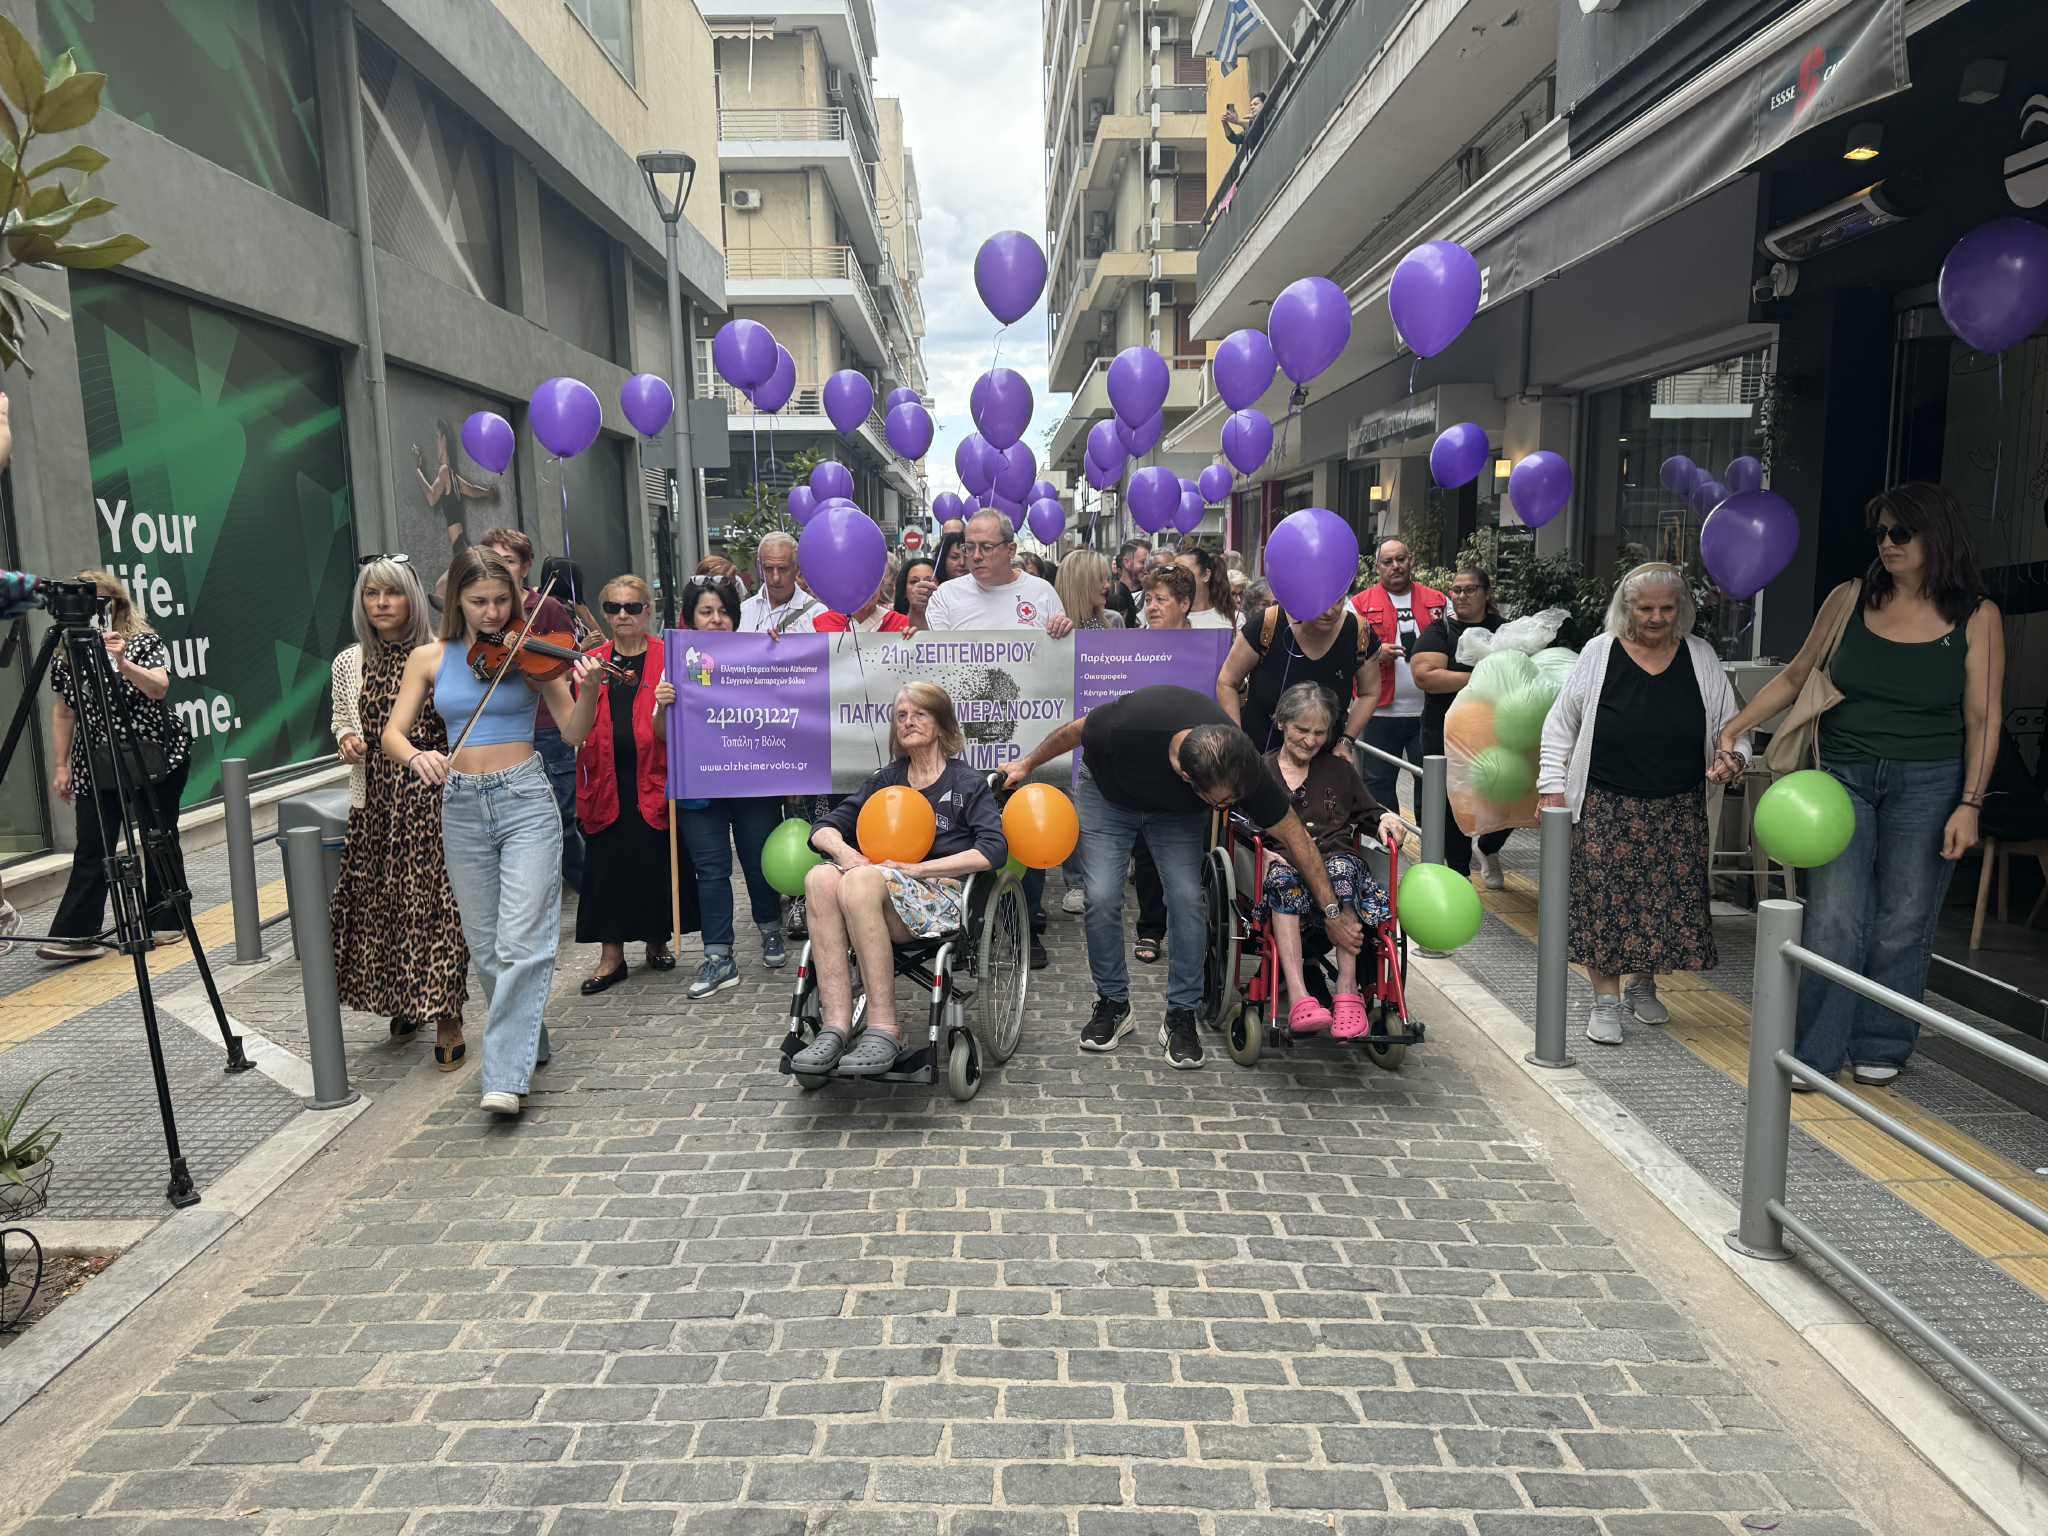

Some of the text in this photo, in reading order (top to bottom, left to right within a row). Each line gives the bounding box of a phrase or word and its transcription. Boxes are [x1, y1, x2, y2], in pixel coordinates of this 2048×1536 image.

[1770, 84, 1796, 111] ESSSE
[96, 499, 197, 553] Your
[163, 635, 210, 679] ur
[881, 642, 1035, 668] 21η ΣΕΠΤΕΜΒΡΙΟΥ
[1080, 653, 1173, 664] Παρέχουμε Δωρεάν
[706, 707, 800, 730] 2421031227
[1006, 700, 1065, 722] ΝΟΣΟΥ
[721, 735, 786, 750] Τοπάλη 7 Βόλος
[700, 760, 808, 773] www.alzheimervolos.gr
